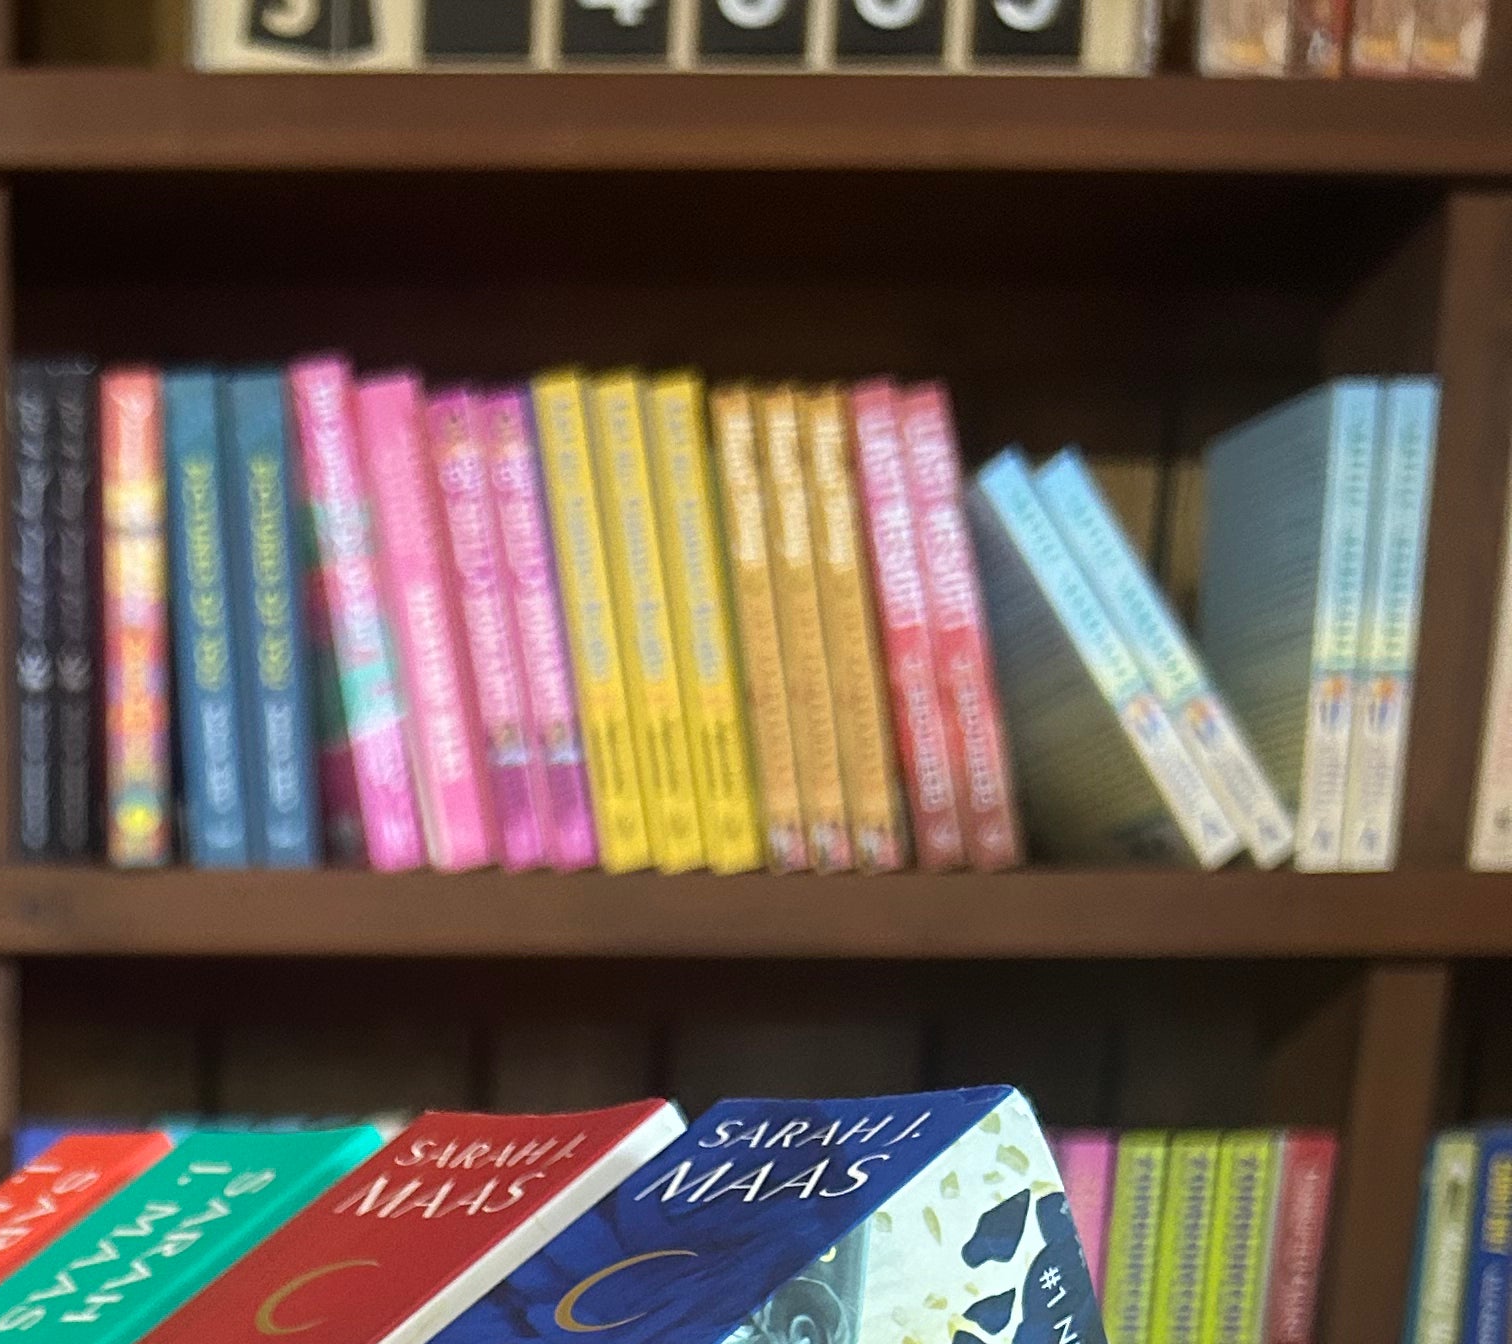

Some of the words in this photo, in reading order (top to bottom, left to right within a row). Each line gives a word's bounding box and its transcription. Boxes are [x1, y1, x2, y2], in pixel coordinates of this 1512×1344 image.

[394, 1137, 560, 1169] SARAH
[698, 1114, 895, 1149] SARAH
[333, 1172, 546, 1219] MAAS
[633, 1152, 892, 1203] MAAS
[59, 1168, 277, 1323] SARAH
[1039, 1265, 1069, 1309] #1
